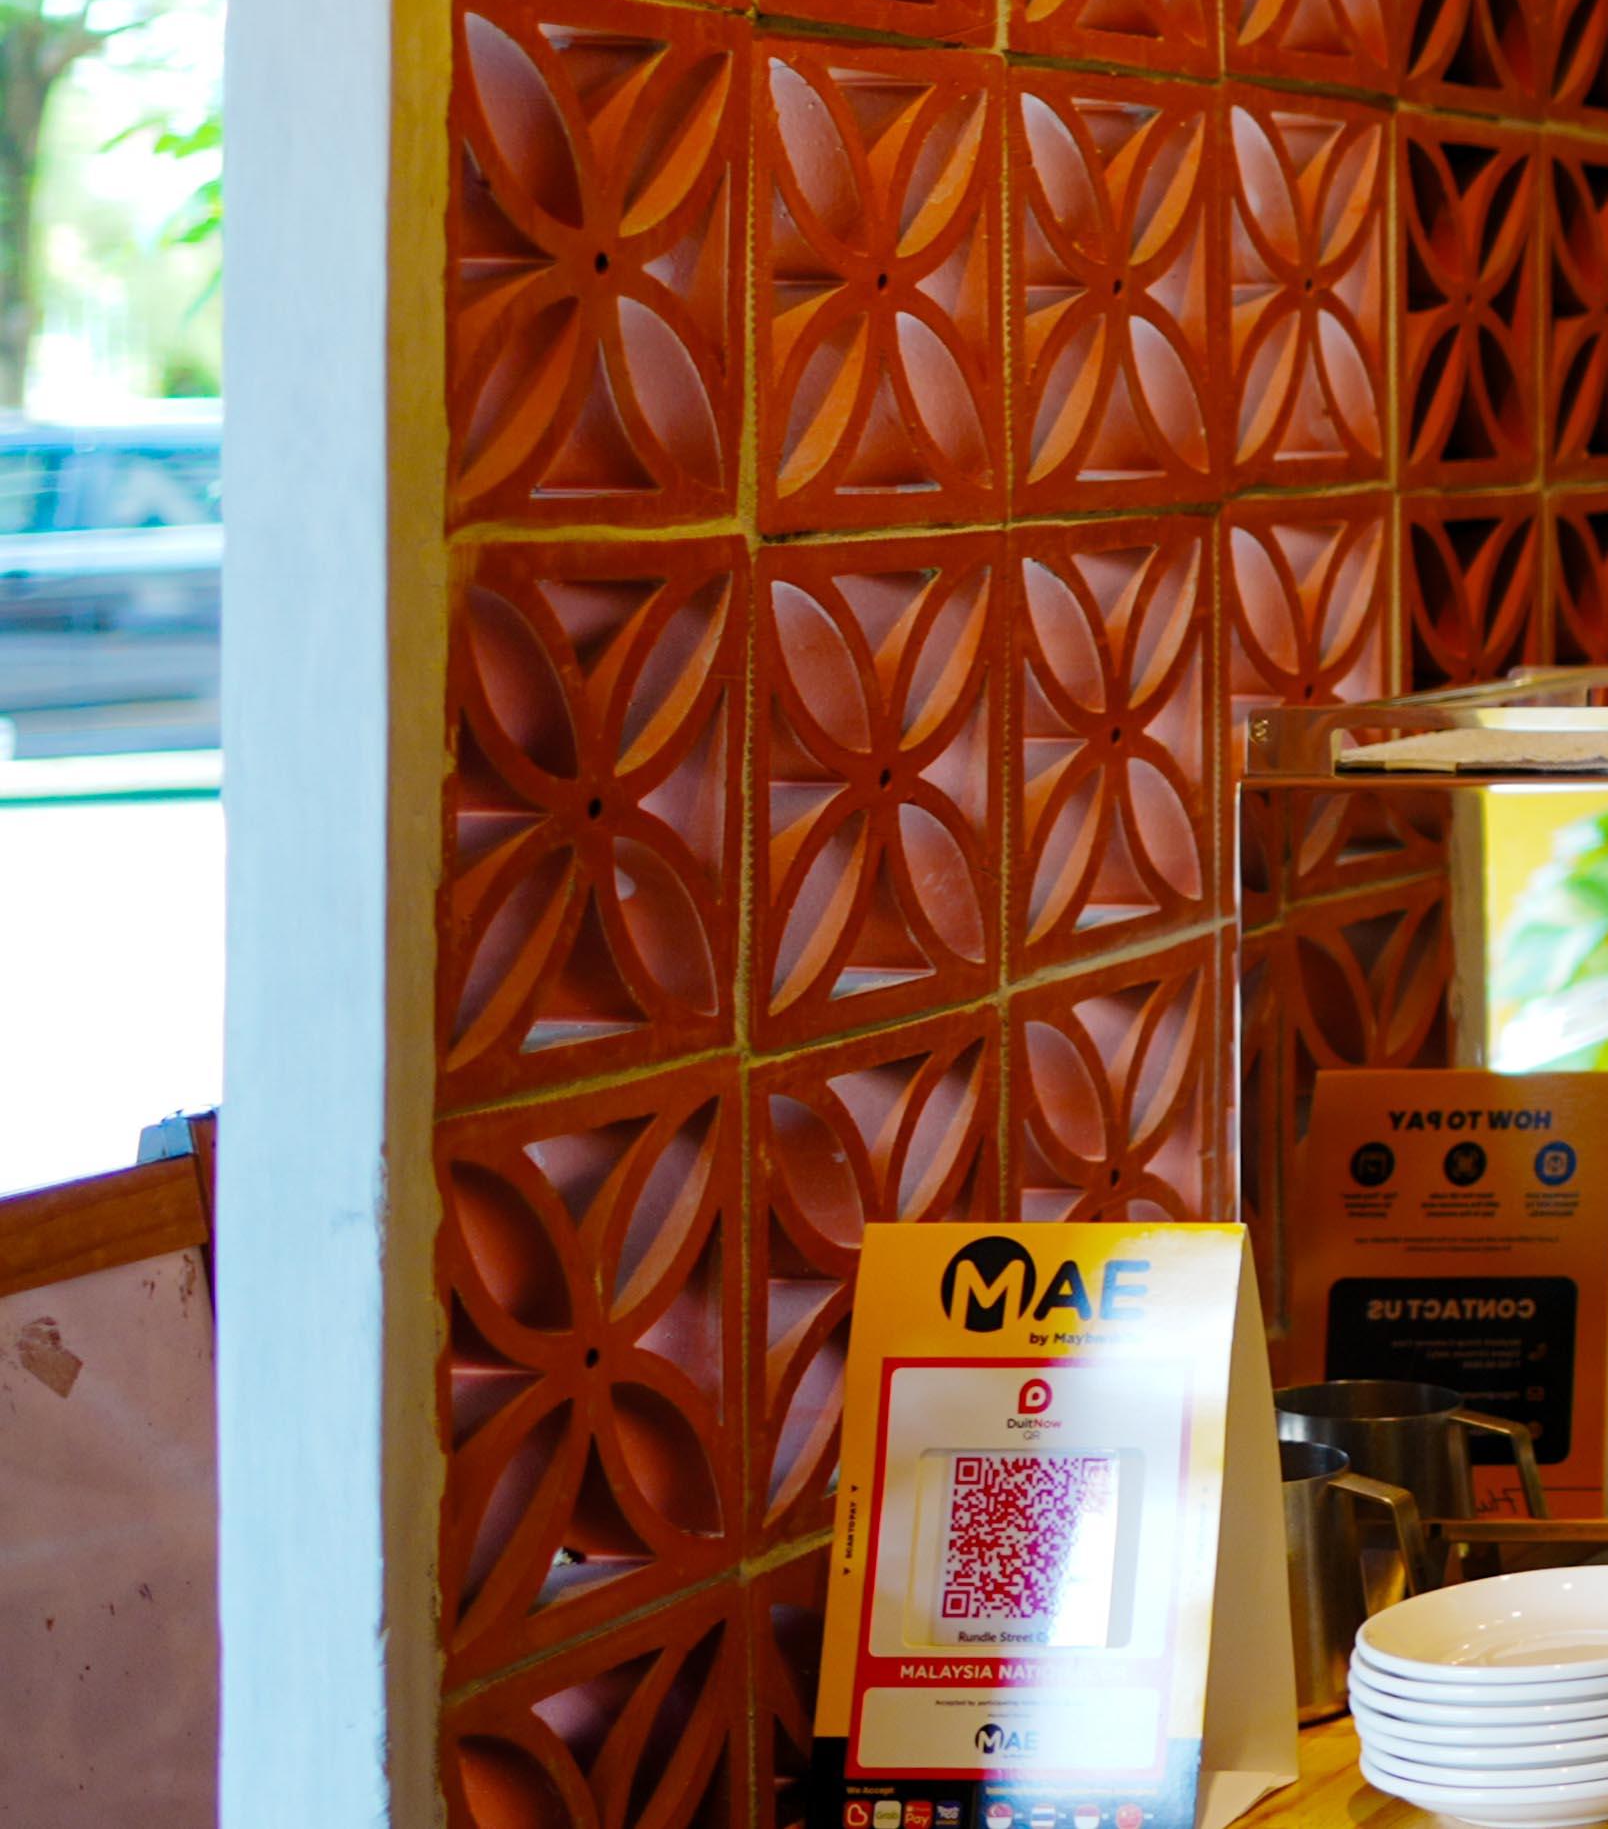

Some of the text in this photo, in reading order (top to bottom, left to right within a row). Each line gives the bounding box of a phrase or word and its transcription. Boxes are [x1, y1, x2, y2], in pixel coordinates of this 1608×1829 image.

[942, 1238, 1151, 1330] MAE
[1029, 1331, 1050, 1346] by
[1006, 1418, 1062, 1430] DuitNow
[1023, 1429, 1041, 1441] QR
[958, 1631, 997, 1643] Rundle
[1000, 1631, 1034, 1643] Street
[900, 1665, 993, 1680] MALAYSIA
[975, 1724, 1039, 1754] MAE
[846, 1786, 895, 1796] We Accept
[905, 1812, 930, 1826] Pay
